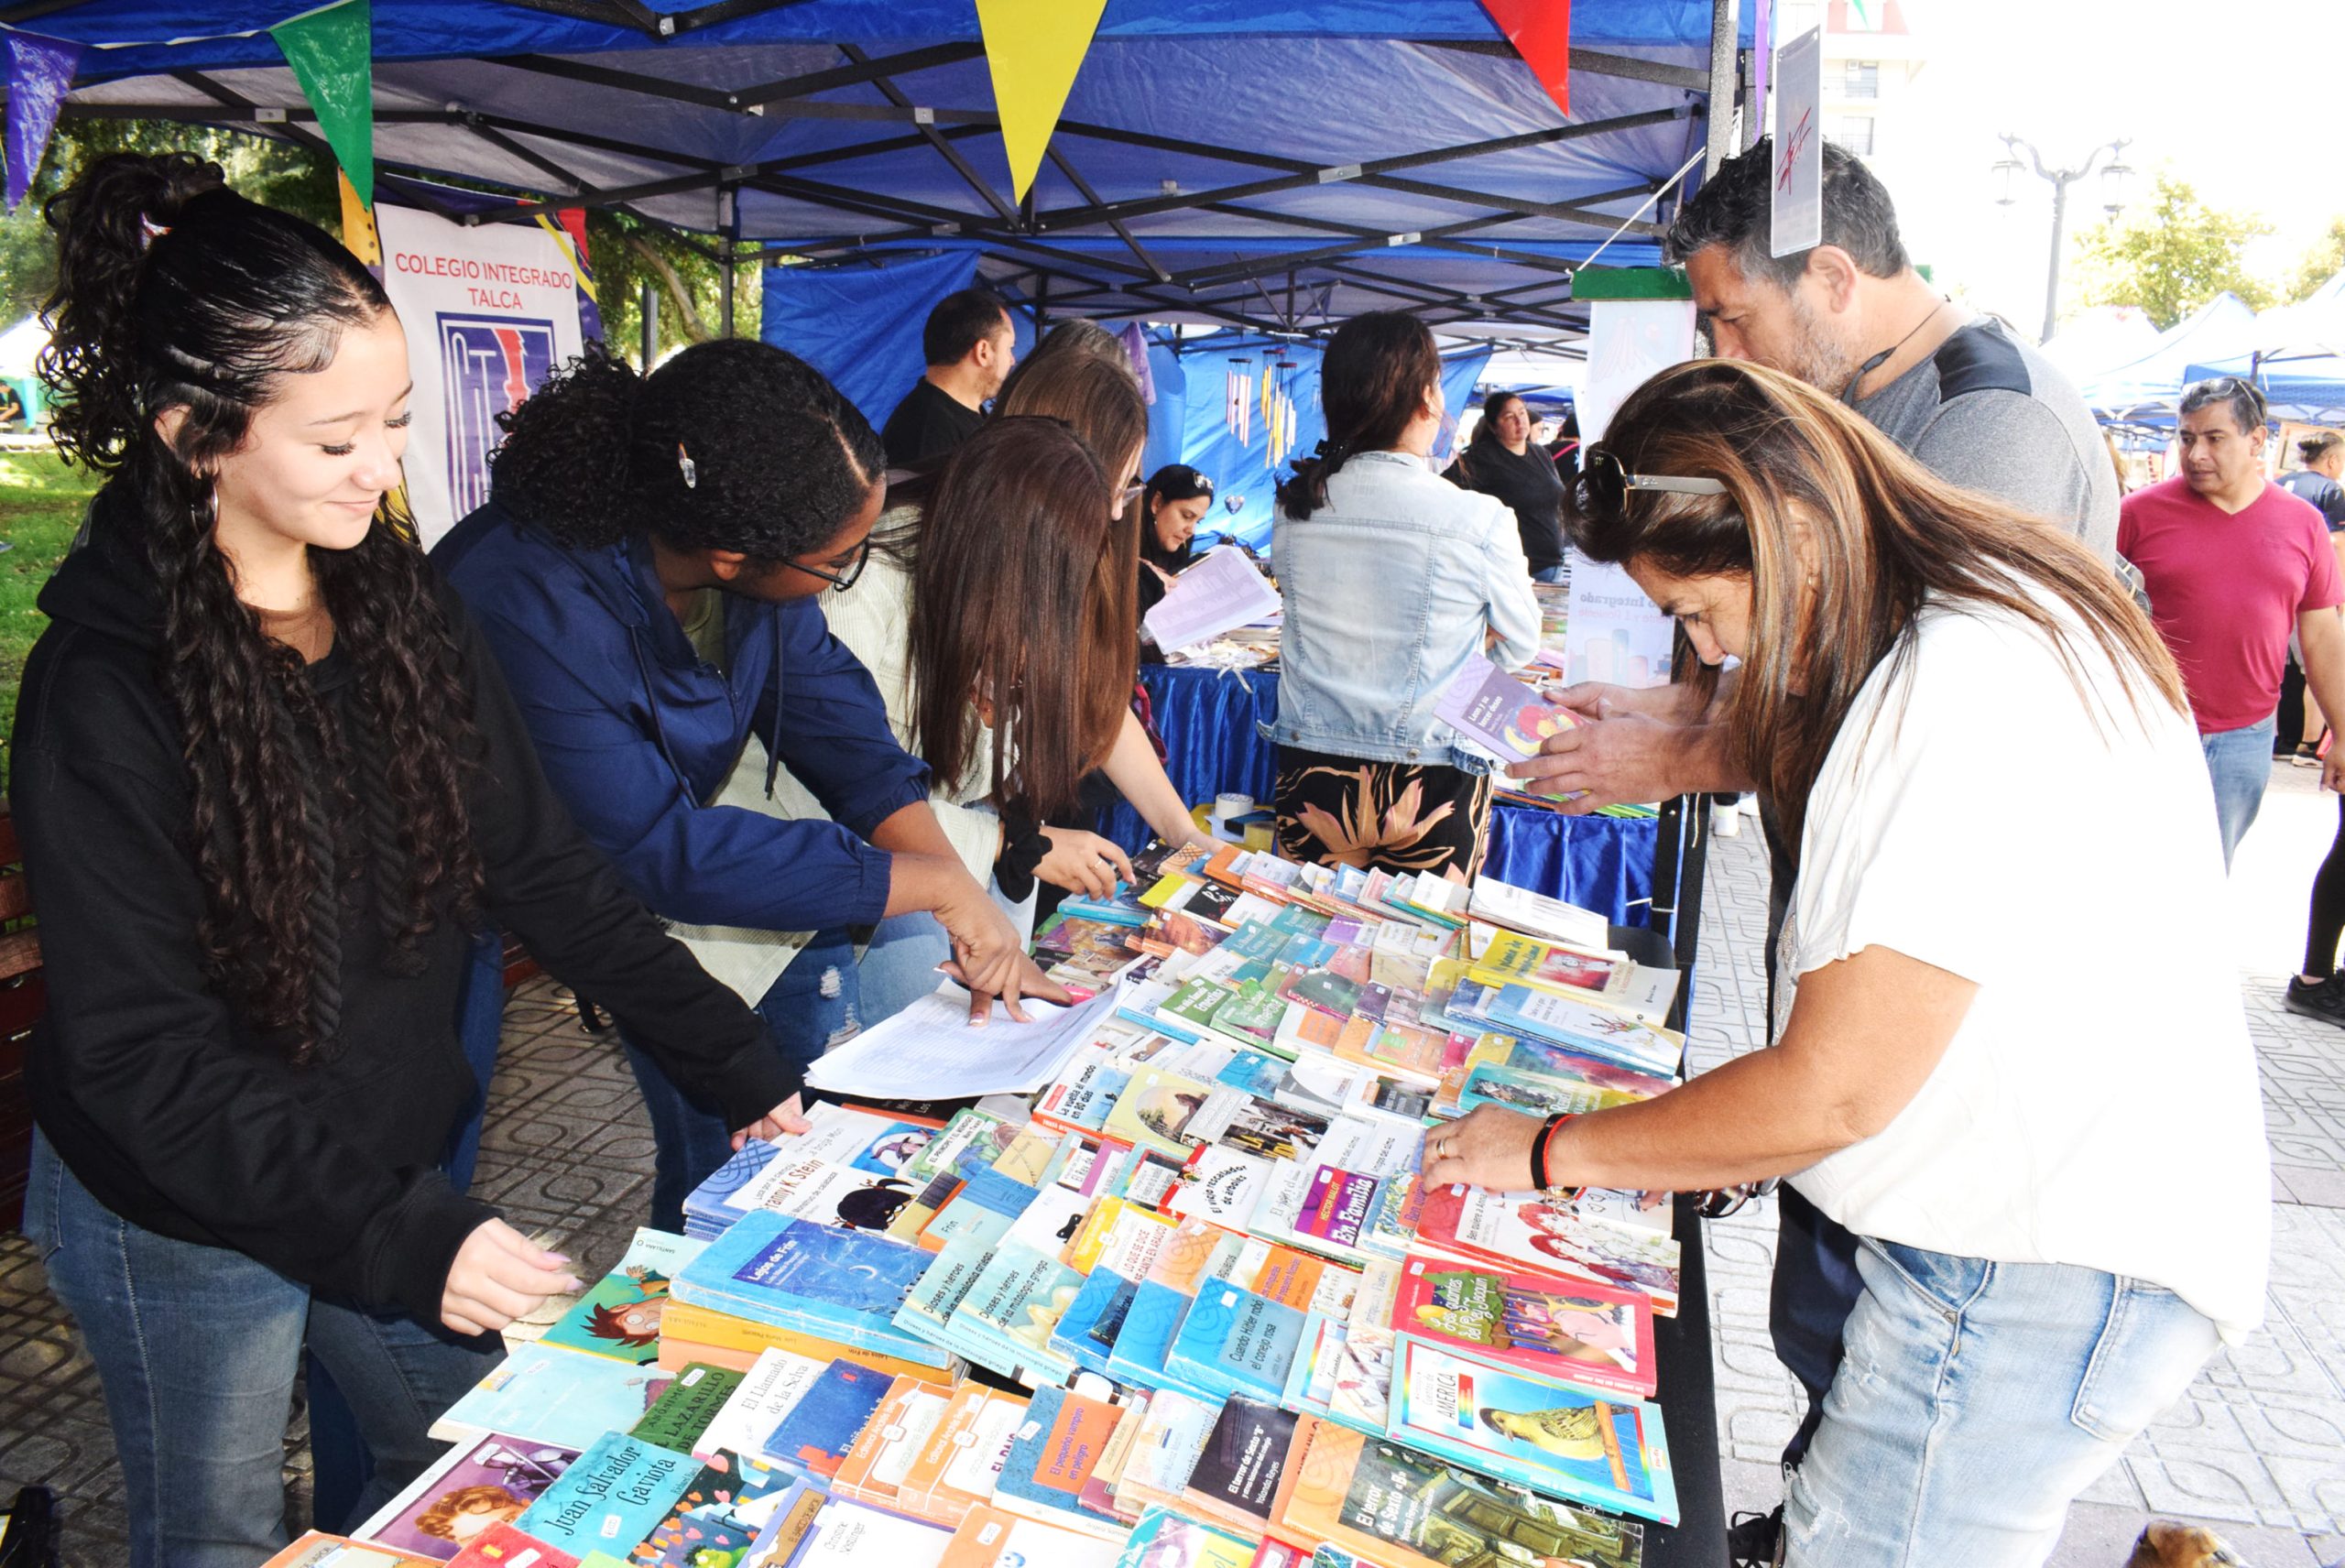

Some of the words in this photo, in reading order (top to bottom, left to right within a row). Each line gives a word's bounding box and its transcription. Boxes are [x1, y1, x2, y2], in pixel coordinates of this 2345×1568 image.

[395, 253, 480, 279] COLEGIO
[484, 264, 573, 289] INTEGRADO
[468, 288, 522, 310] TALCA
[1478, 711, 1493, 727] tercer
[1489, 695, 1503, 712] deseo
[1063, 1090, 1080, 1106] vuelta
[1079, 1064, 1096, 1083] mundo
[956, 1116, 974, 1132] MENDIGO
[970, 1119, 981, 1129] Twain
[766, 1181, 795, 1207] ranny
[793, 1160, 826, 1181] Stein
[1326, 1181, 1340, 1198] MALOT
[1338, 1178, 1374, 1224] Familia
[1476, 1193, 1489, 1208] Anna
[940, 1220, 958, 1232] Frin
[1332, 1225, 1358, 1241] En
[1467, 1229, 1478, 1240] Ben
[1470, 1213, 1483, 1229] quiere
[747, 1262, 772, 1280] Lejos
[777, 1237, 797, 1254] Frin
[1127, 1251, 1140, 1264] QUE
[1136, 1229, 1150, 1244] DICE
[1138, 1256, 1153, 1273] CANTA
[1151, 1225, 1168, 1247] ARAUCO
[922, 1290, 946, 1313] Dioses
[943, 1262, 965, 1284] héroes
[953, 1274, 977, 1301] mitología
[974, 1252, 993, 1272] griega
[1008, 1280, 1035, 1310] mitología
[1029, 1259, 1049, 1282] griega
[979, 1296, 1001, 1319] Dioses
[998, 1269, 1020, 1290] héroes
[1441, 1278, 1465, 1309] guantes
[1463, 1278, 1492, 1307] Joaquín
[1227, 1334, 1250, 1361] Cuando
[1239, 1315, 1259, 1334] Hitler
[1249, 1299, 1265, 1315] robó
[1252, 1338, 1272, 1362] conejo
[1262, 1323, 1277, 1337] rosa
[740, 1397, 759, 1410] El
[750, 1358, 788, 1397] Llamado
[782, 1364, 809, 1389] Selva
[649, 1386, 686, 1428] ANÓNIMO
[666, 1372, 725, 1438] LAZARILLO
[766, 1400, 784, 1413] de
[774, 1388, 792, 1400] la
[677, 1432, 697, 1452] DE
[692, 1386, 736, 1439] TORMES
[856, 1433, 878, 1457] Editorial
[1052, 1435, 1074, 1467] pequeño
[1065, 1407, 1085, 1435] vampiro
[1243, 1435, 1260, 1455] Sexto
[924, 1439, 947, 1464] Editorial
[1070, 1444, 1091, 1468] peligro
[1238, 1454, 1251, 1465] de
[617, 1457, 676, 1506] Gaviota
[1230, 1464, 1247, 1486] terror
[1246, 1460, 1261, 1481] historias
[1254, 1478, 1272, 1504] Yolanda
[1263, 1461, 1280, 1478] Reyes
[545, 1498, 592, 1537] Juan
[575, 1446, 642, 1500] Salvador
[1226, 1485, 1238, 1493] El
[1359, 1485, 1382, 1513] terror
[1354, 1513, 1373, 1525] El
[1380, 1490, 1404, 1520] Sexto
[1404, 1499, 1421, 1518] Reyes
[1377, 1519, 1394, 1534] de
[1397, 1519, 1413, 1541] Yolanda
